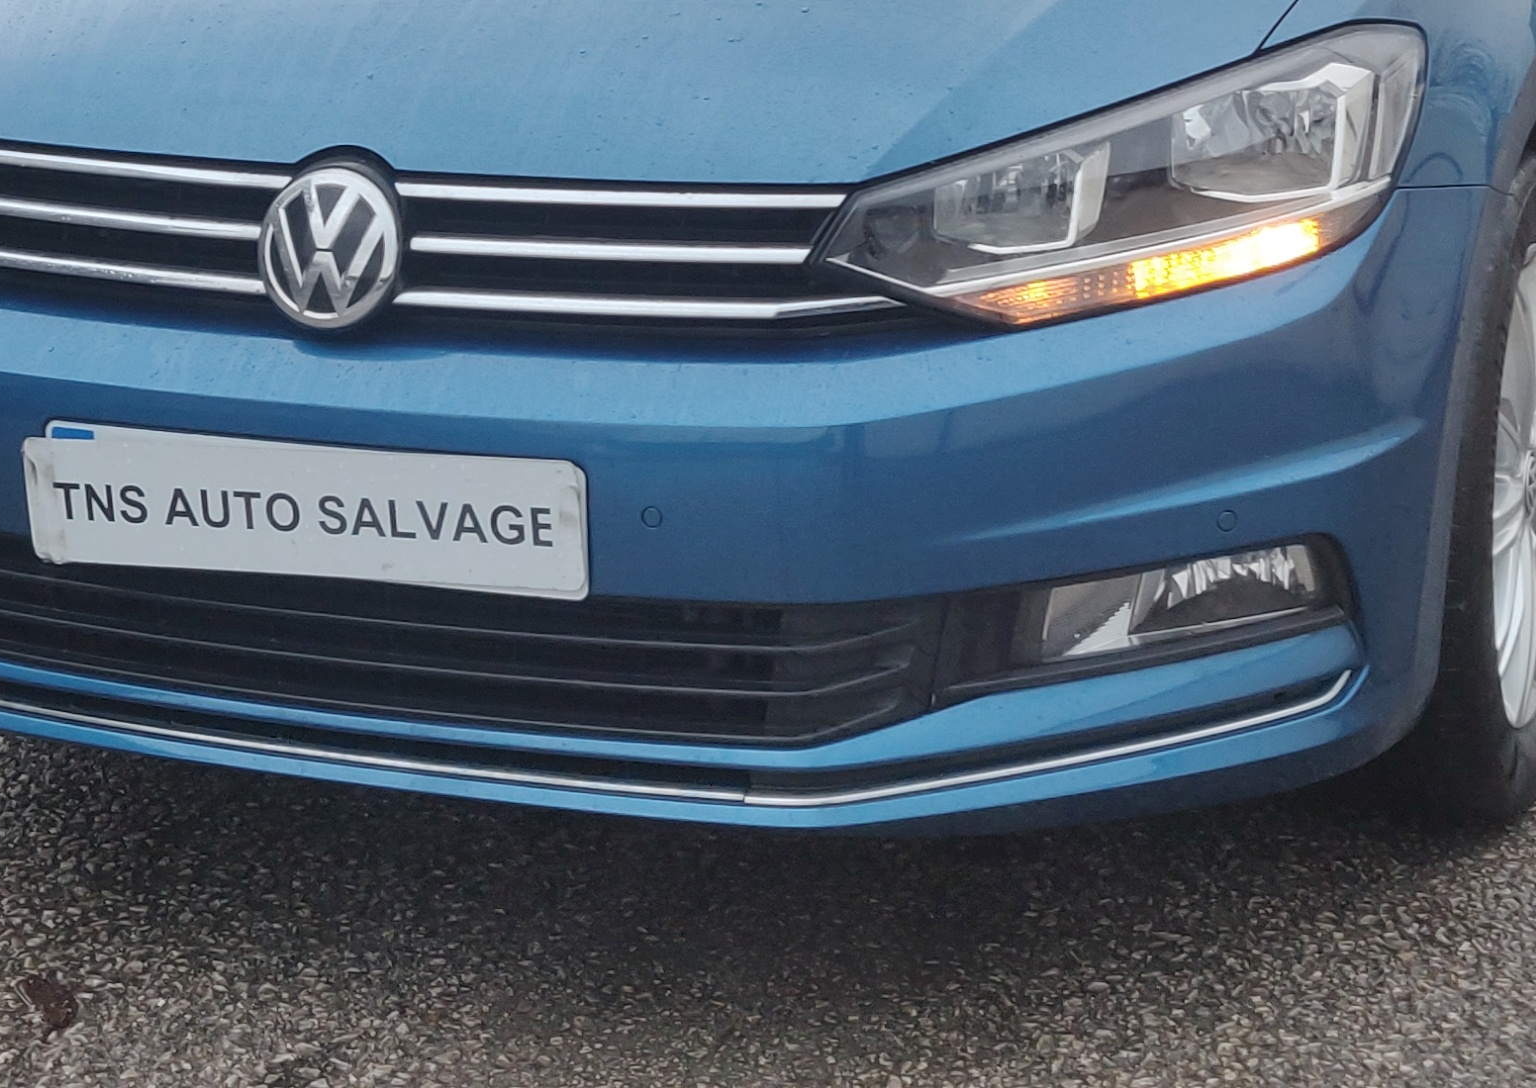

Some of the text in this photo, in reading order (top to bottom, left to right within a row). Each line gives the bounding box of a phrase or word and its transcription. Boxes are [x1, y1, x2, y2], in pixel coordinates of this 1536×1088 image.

[52, 481, 554, 548] TNS AUTO SALVAGE
